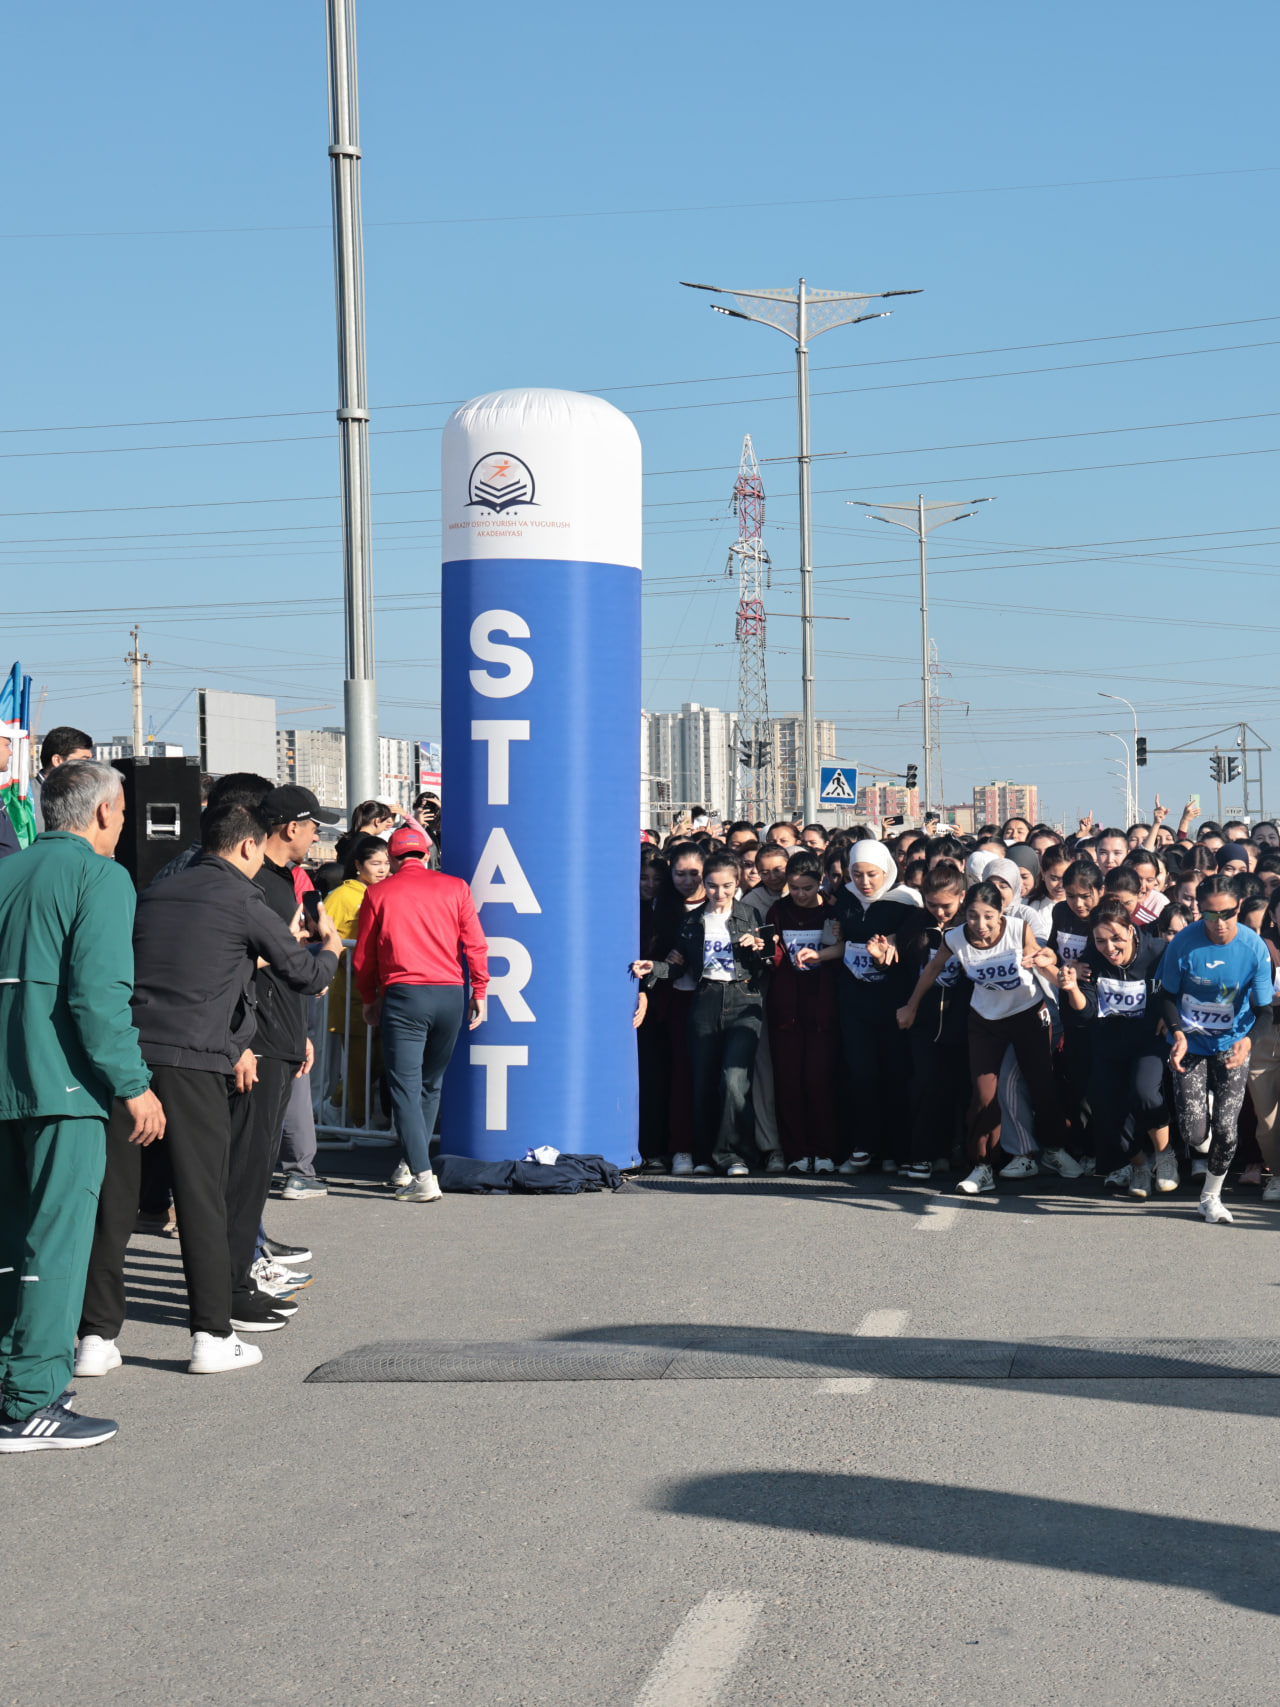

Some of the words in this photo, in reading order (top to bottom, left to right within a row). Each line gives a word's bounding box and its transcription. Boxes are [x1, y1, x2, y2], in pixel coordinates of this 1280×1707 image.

[471, 520, 491, 528] OSIYO
[491, 520, 517, 528] YURISH
[530, 520, 571, 528] YUGURUSH
[469, 609, 542, 1131] START
[976, 963, 1017, 980] 3986
[1104, 991, 1146, 1006] 7909
[1191, 1009, 1232, 1023] 3776
